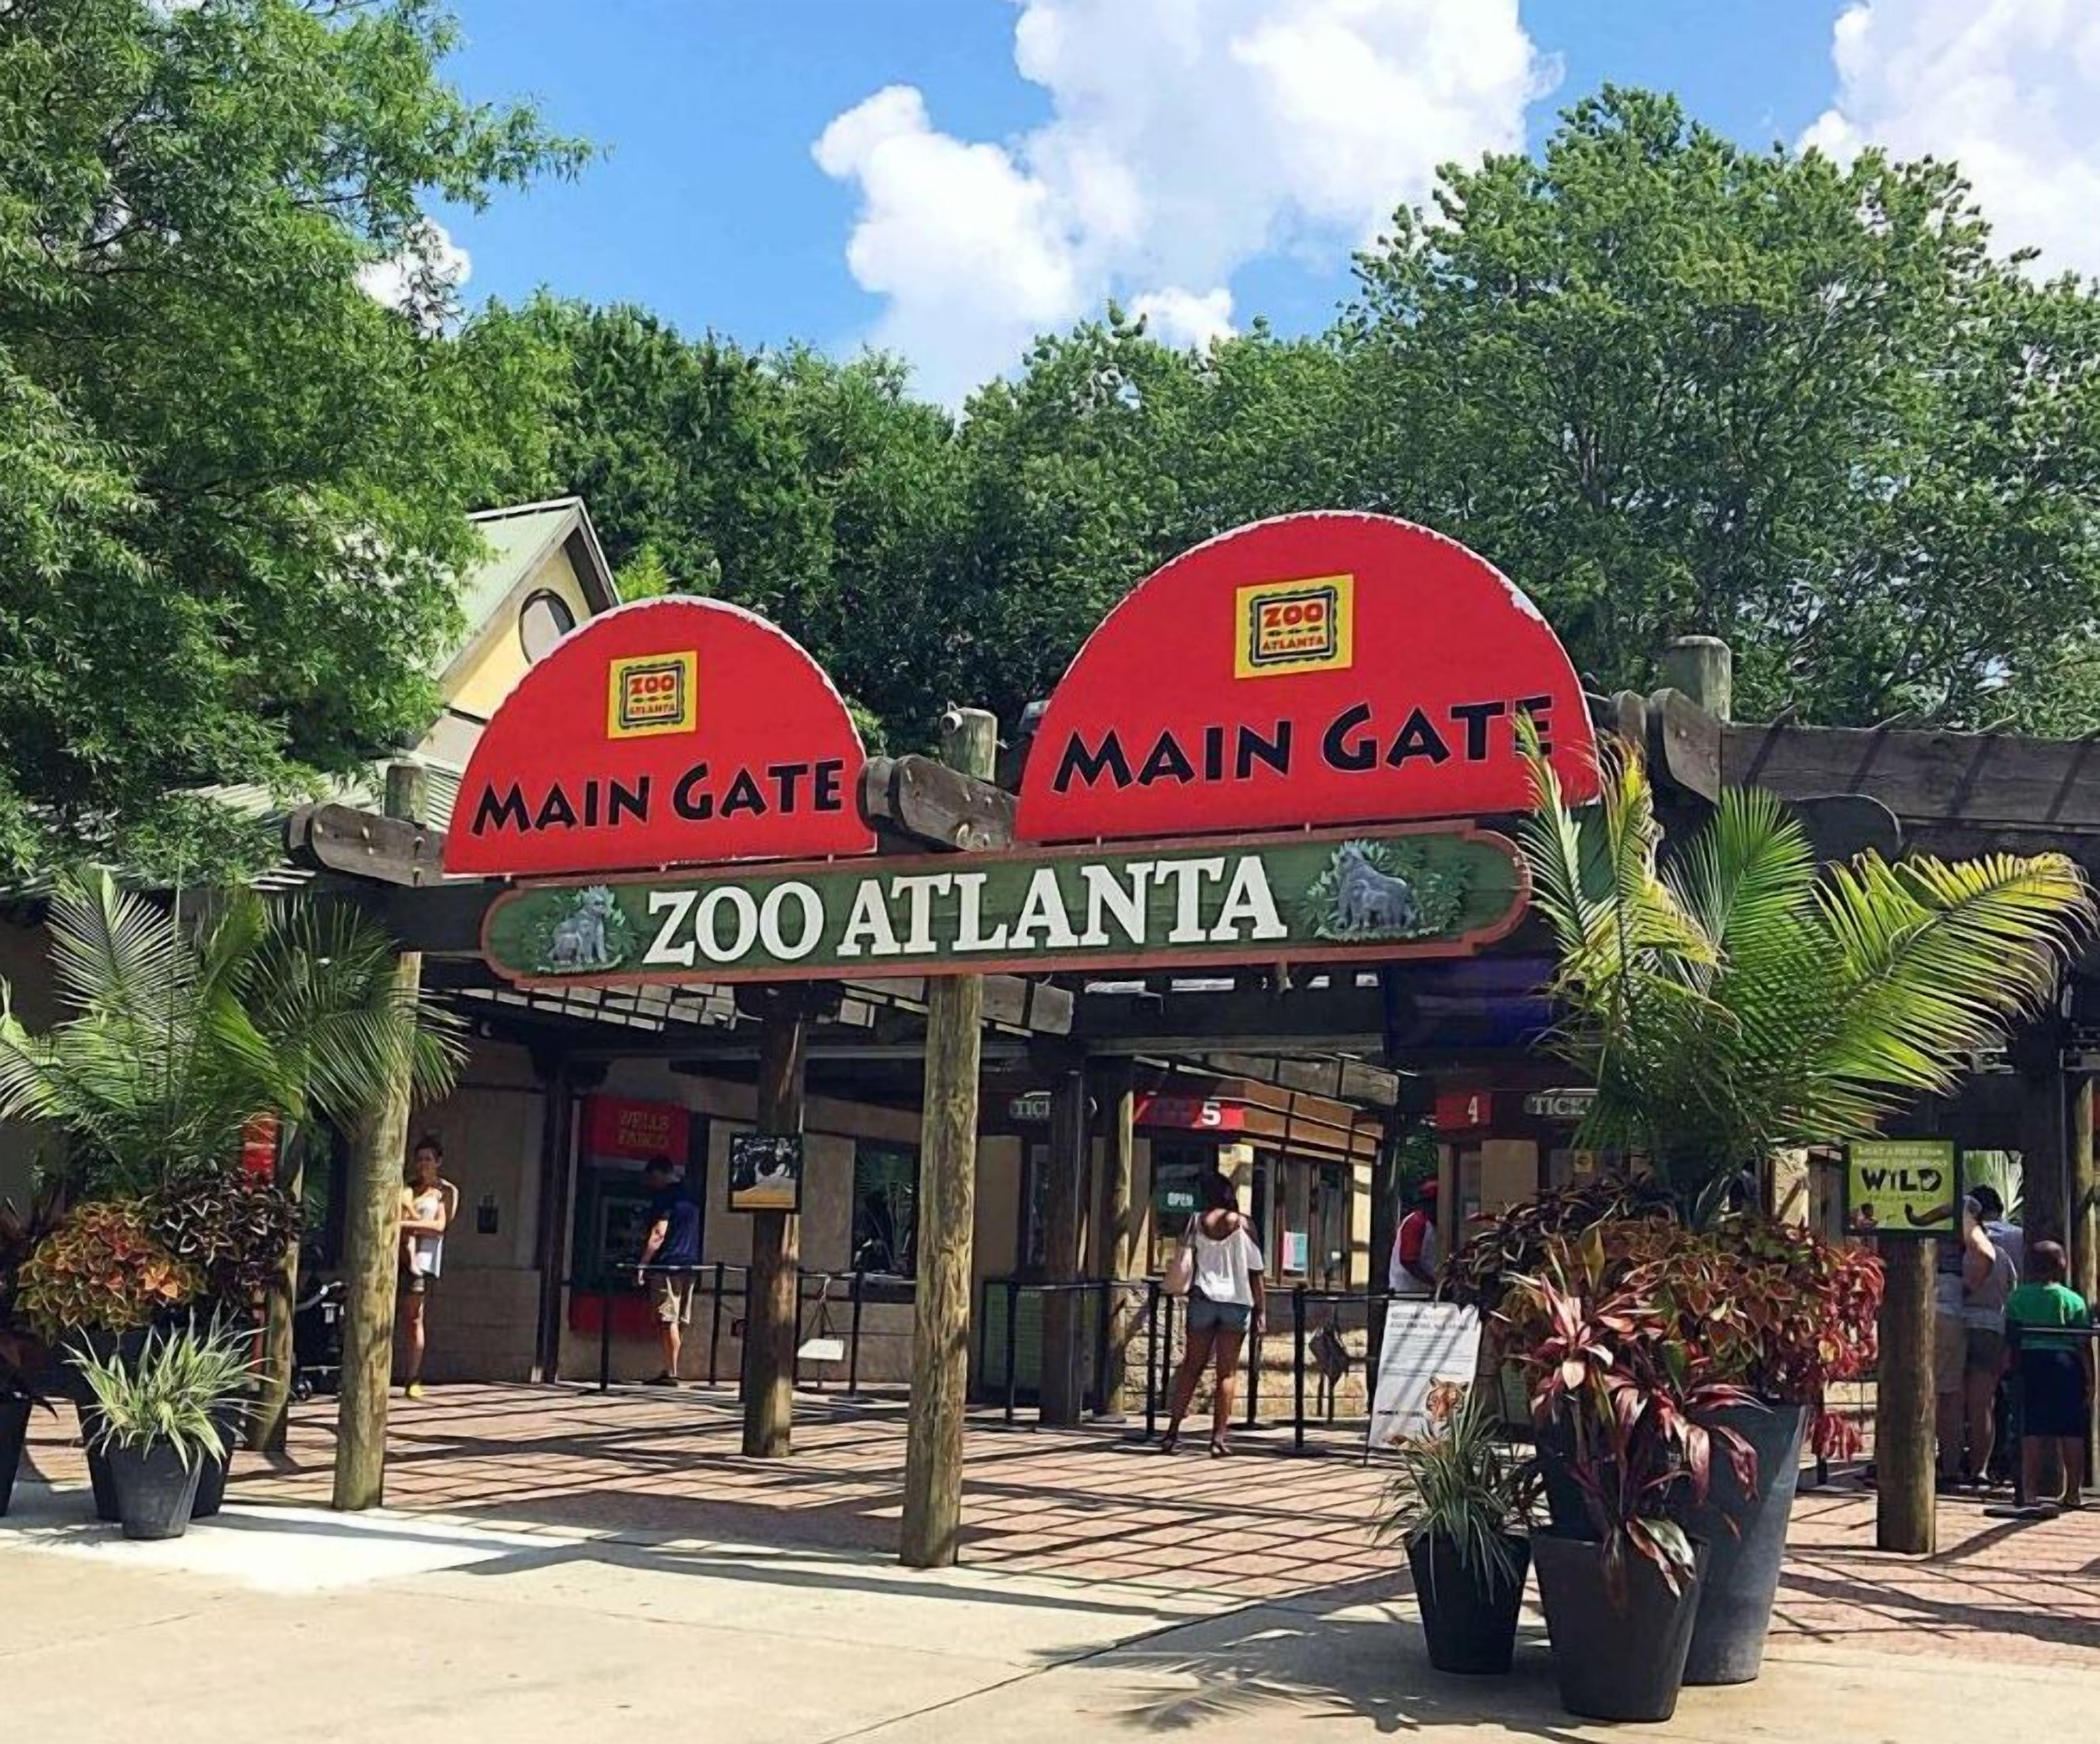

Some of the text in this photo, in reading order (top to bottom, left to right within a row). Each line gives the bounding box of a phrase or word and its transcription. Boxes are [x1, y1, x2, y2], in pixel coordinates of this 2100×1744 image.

[1263, 603, 1324, 628] ZOO
[1262, 636, 1324, 650] ATLANTA
[629, 675, 675, 694] ZOO
[1053, 695, 1553, 793] MAIN GATE
[471, 759, 844, 836] MAIN GATE
[642, 855, 1288, 966] ZOO ATLANTA
[1202, 1101, 1221, 1125] 5
[1468, 1096, 1478, 1123] 4
[1861, 1168, 1943, 1192] WILD
